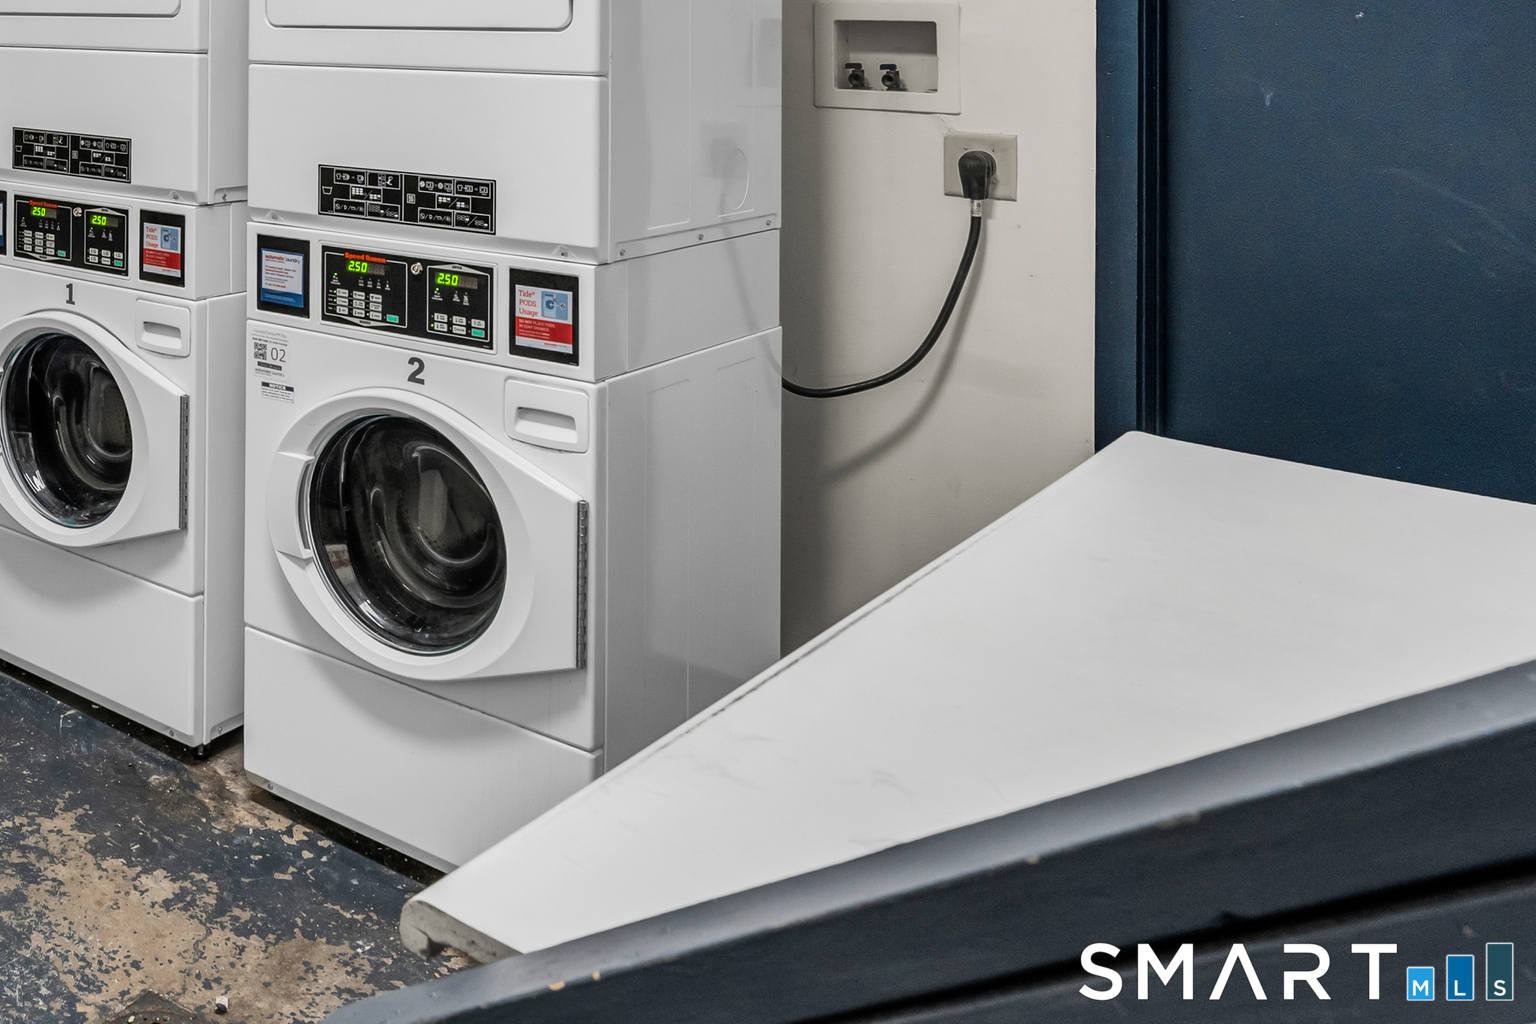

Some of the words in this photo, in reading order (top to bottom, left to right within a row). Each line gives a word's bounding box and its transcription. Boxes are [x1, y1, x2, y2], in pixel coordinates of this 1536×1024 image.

[344, 252, 364, 260] Speed
[365, 255, 386, 263] Queen
[348, 260, 368, 273] 2.50
[437, 272, 459, 286] 2.50
[65, 283, 76, 305] 1
[519, 298, 537, 308] PODS
[518, 307, 539, 317] Usage
[270, 347, 286, 363] 02
[407, 357, 425, 385] 2
